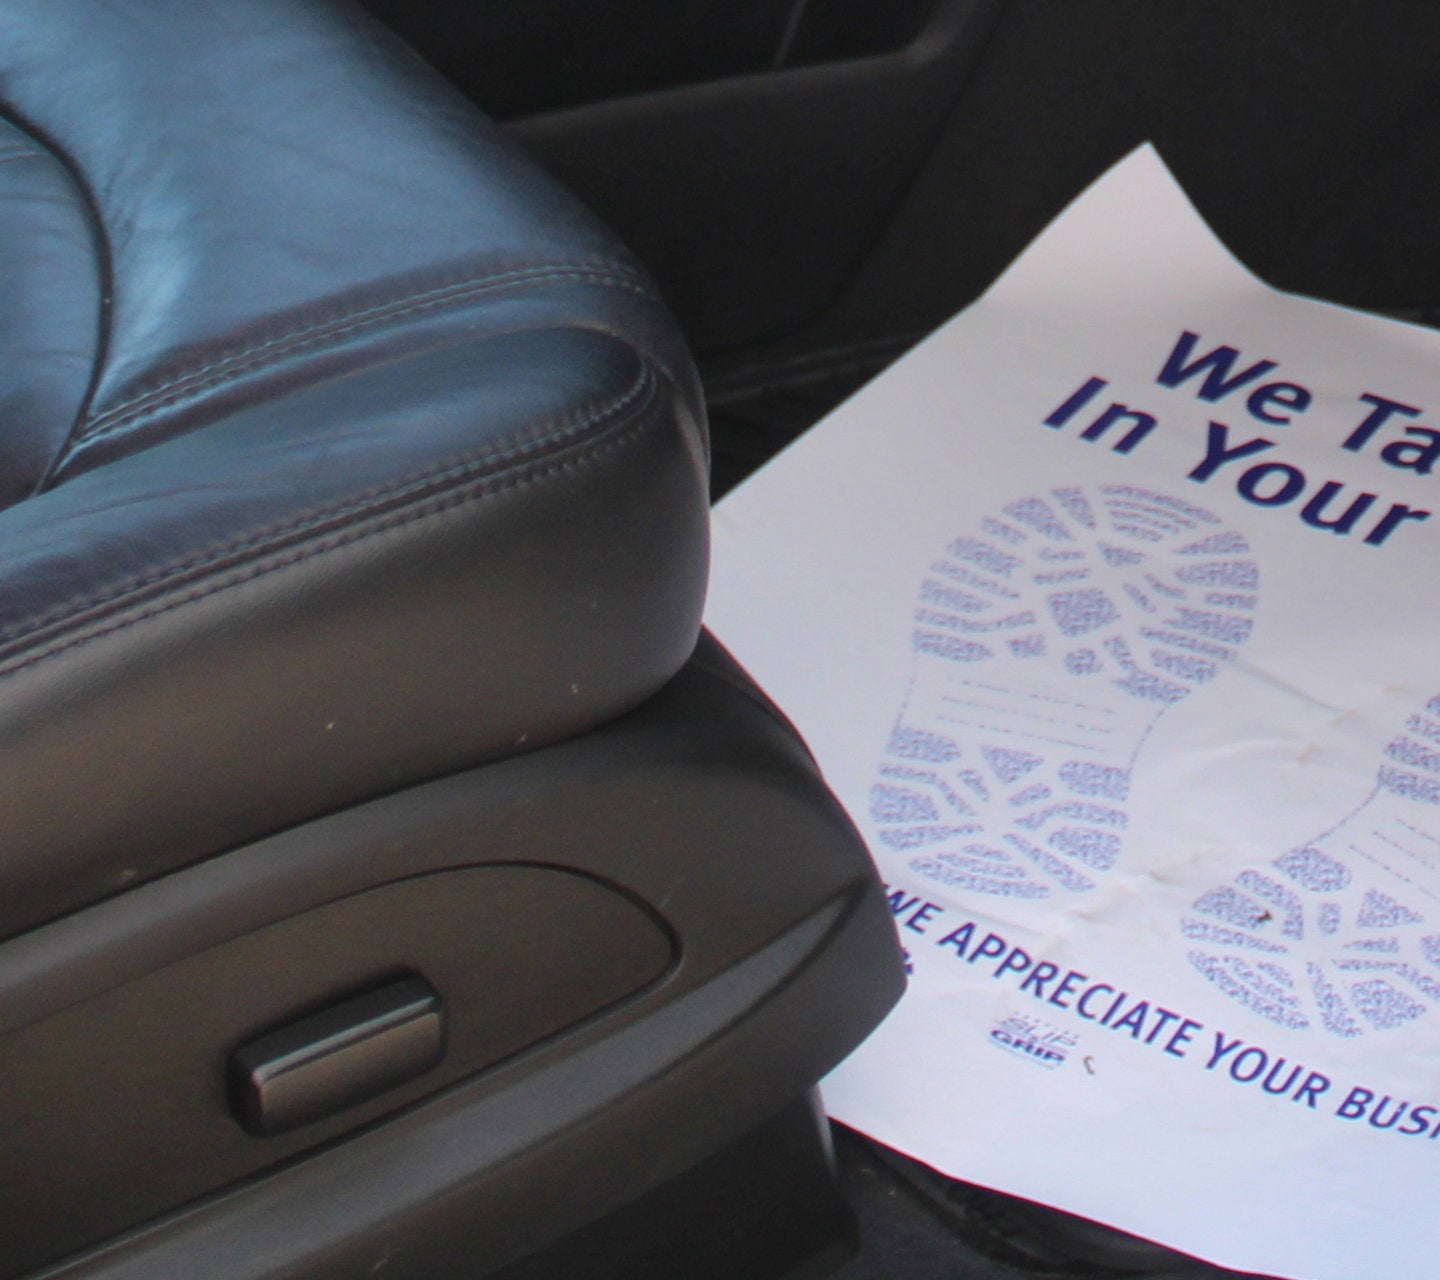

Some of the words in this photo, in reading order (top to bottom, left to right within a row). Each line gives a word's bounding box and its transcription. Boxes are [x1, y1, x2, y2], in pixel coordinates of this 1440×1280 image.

[1043, 376, 1158, 455] In
[1187, 420, 1432, 547] Your
[1156, 330, 1312, 426] We
[936, 921, 1205, 1058] APPRECIATE
[1205, 1031, 1331, 1109] YOUR
